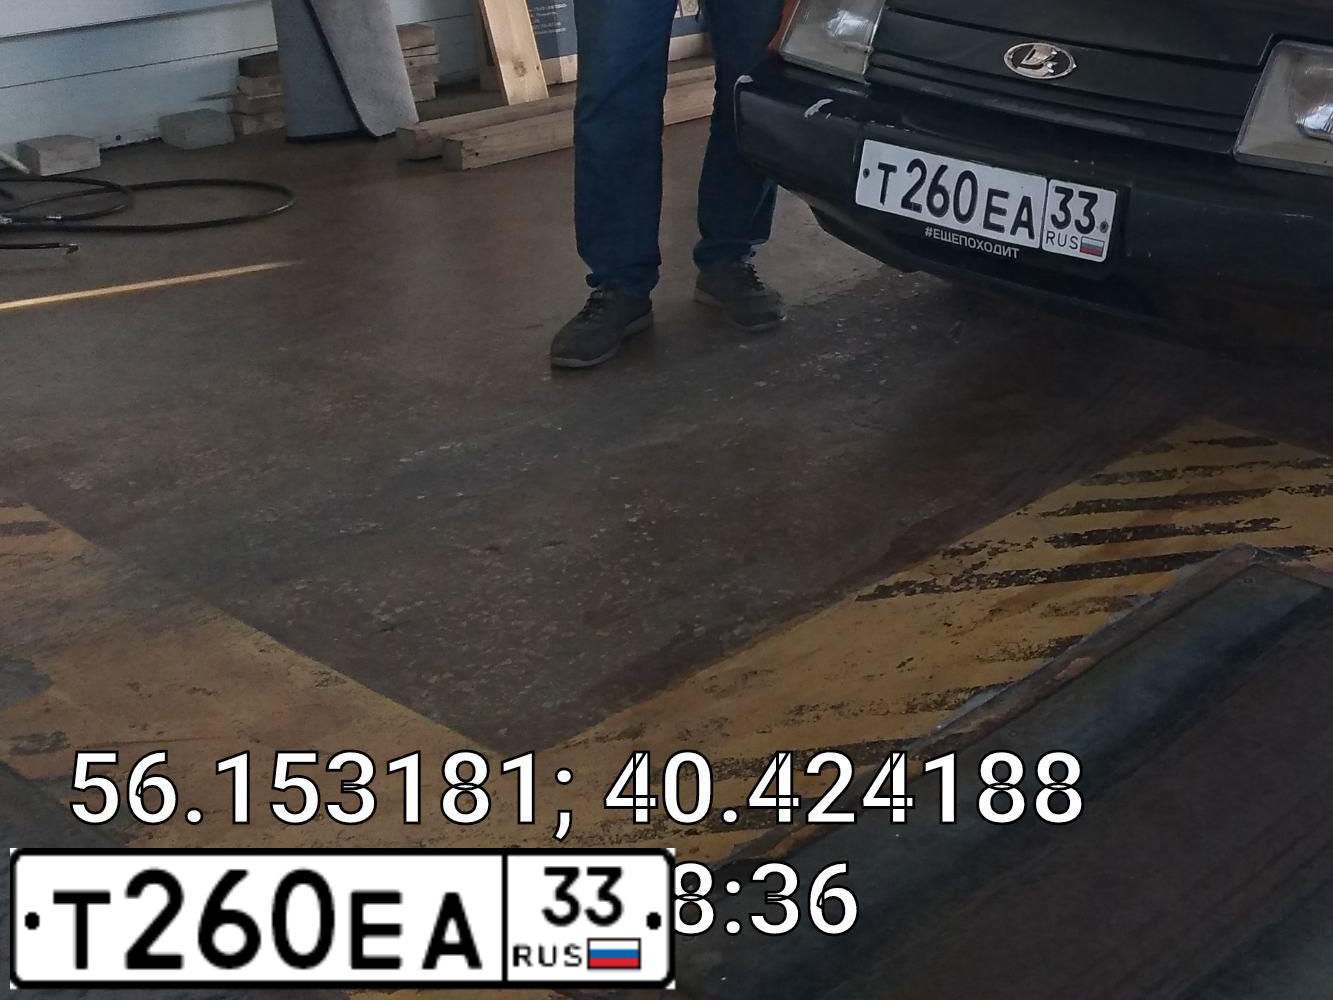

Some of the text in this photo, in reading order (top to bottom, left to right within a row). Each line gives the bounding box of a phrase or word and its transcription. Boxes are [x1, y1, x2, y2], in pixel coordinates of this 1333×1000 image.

[877, 158, 1099, 240] Т260ЕА 33
[1045, 230, 1079, 250] RUS
